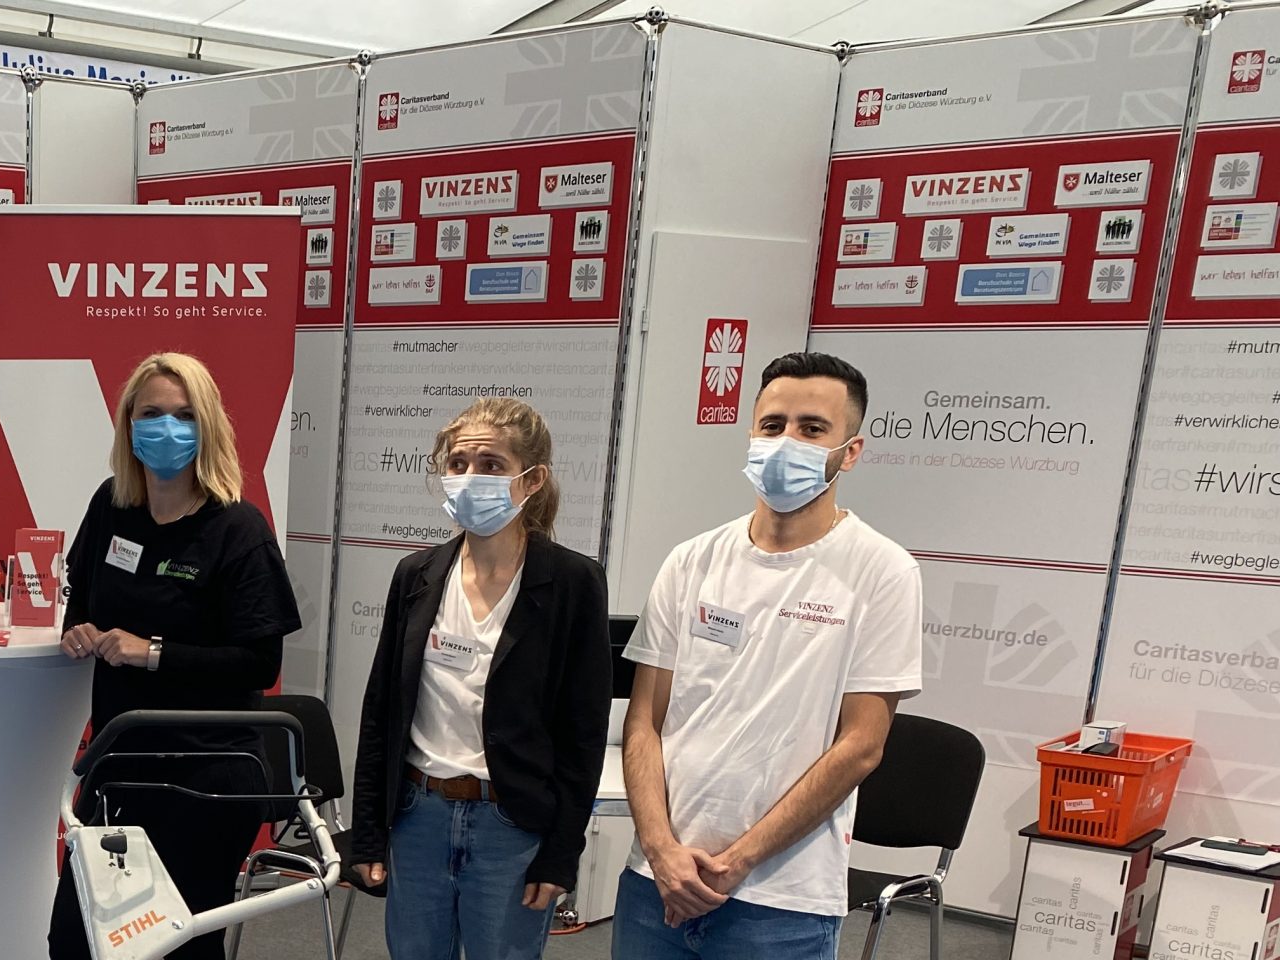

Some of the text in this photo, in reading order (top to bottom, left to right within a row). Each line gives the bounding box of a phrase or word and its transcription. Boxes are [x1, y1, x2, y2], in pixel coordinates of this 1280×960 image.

[401, 92, 449, 104] Caritasverband
[885, 88, 948, 101] Caritasverband
[884, 102, 894, 112] für
[895, 101, 906, 110] die
[908, 99, 938, 111] Diözese
[939, 95, 977, 109] Würzburg
[166, 122, 205, 132] Caritasverband
[561, 172, 607, 187] Malteser
[1084, 170, 1142, 185] Malteser
[295, 195, 331, 206] Malteser
[86, 305, 267, 319] Respekt! So geht Service.
[393, 340, 458, 353] #mutmacher
[423, 384, 532, 397] #caritasunterfranken
[923, 391, 1051, 411] Gemeinsam.
[365, 405, 432, 417] #verwirklicher
[870, 411, 1095, 446] die Menschen.
[1174, 414, 1280, 429] #verwirkliche
[861, 449, 905, 467] Caritas
[909, 454, 920, 467] in
[923, 452, 947, 468] der
[950, 453, 1005, 470] Diözese
[382, 523, 452, 539] #wegbegleiter
[798, 601, 834, 614] VINZENZ
[778, 608, 845, 625] Serviceleistungen
[1133, 639, 1280, 670] Caritasverba
[1129, 662, 1155, 681] für
[1161, 665, 1191, 685] die
[107, 910, 167, 948] STIHL
[1034, 912, 1096, 932] caritas
